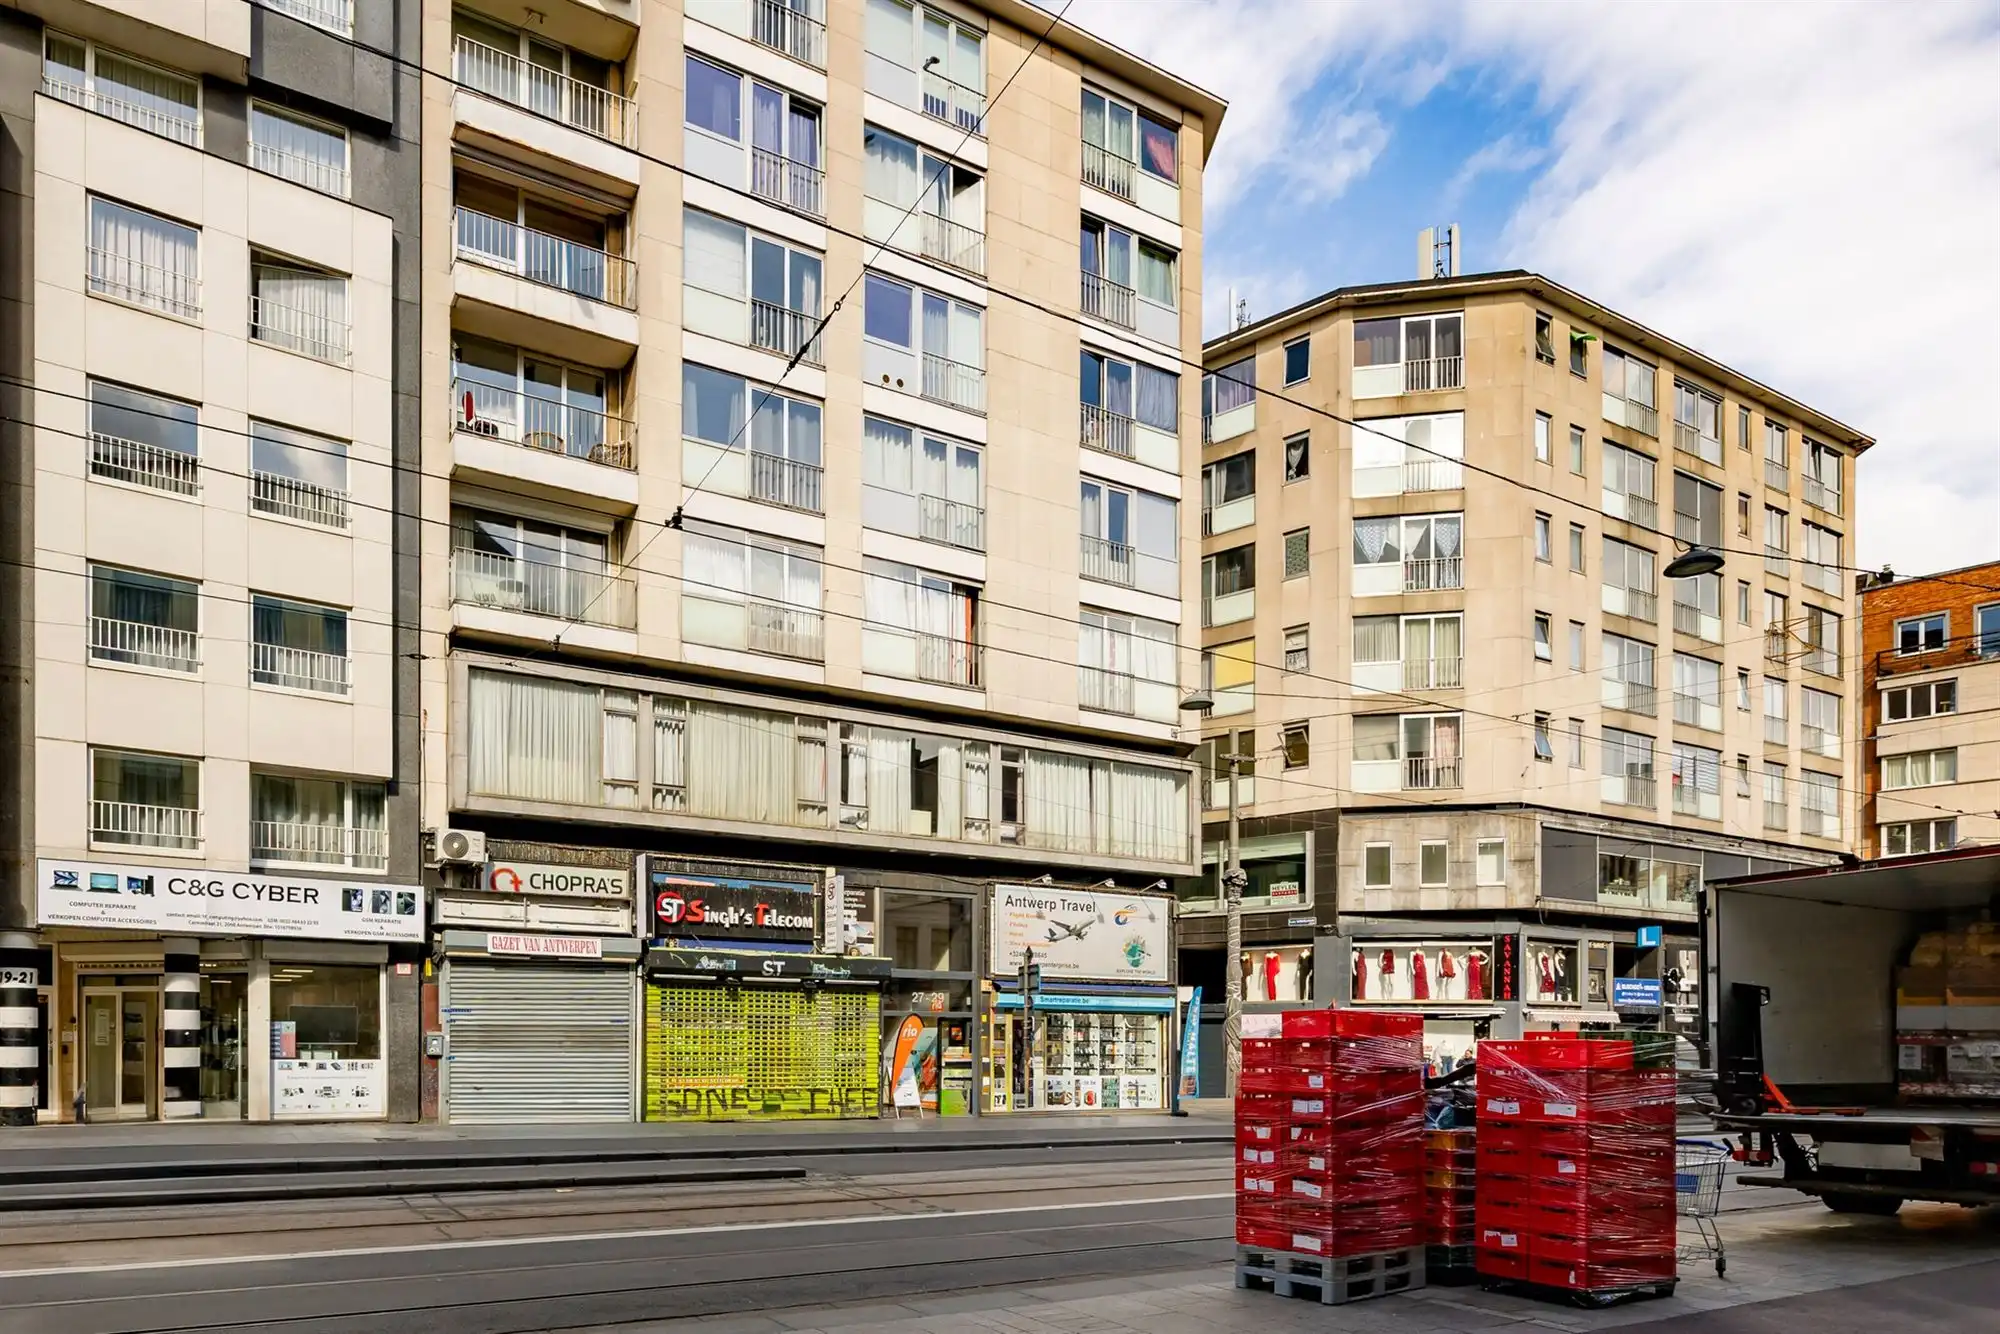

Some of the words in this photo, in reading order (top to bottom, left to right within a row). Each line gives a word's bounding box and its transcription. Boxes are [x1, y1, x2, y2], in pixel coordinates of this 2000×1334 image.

[168, 878, 224, 898] C&G
[232, 883, 319, 904] CYBER
[530, 873, 623, 894] CHOPRA'S
[1005, 895, 1056, 912] Antwerp
[1060, 899, 1096, 912] Travel
[118, 917, 157, 925] ACCESSOIRES
[492, 936, 520, 951] GAZET
[523, 937, 540, 952] VAN
[543, 939, 597, 954] ANTWERPEN
[1641, 928, 1657, 946] L
[1503, 935, 1512, 1000] SAVANNAH
[902, 1024, 918, 1037] ria
